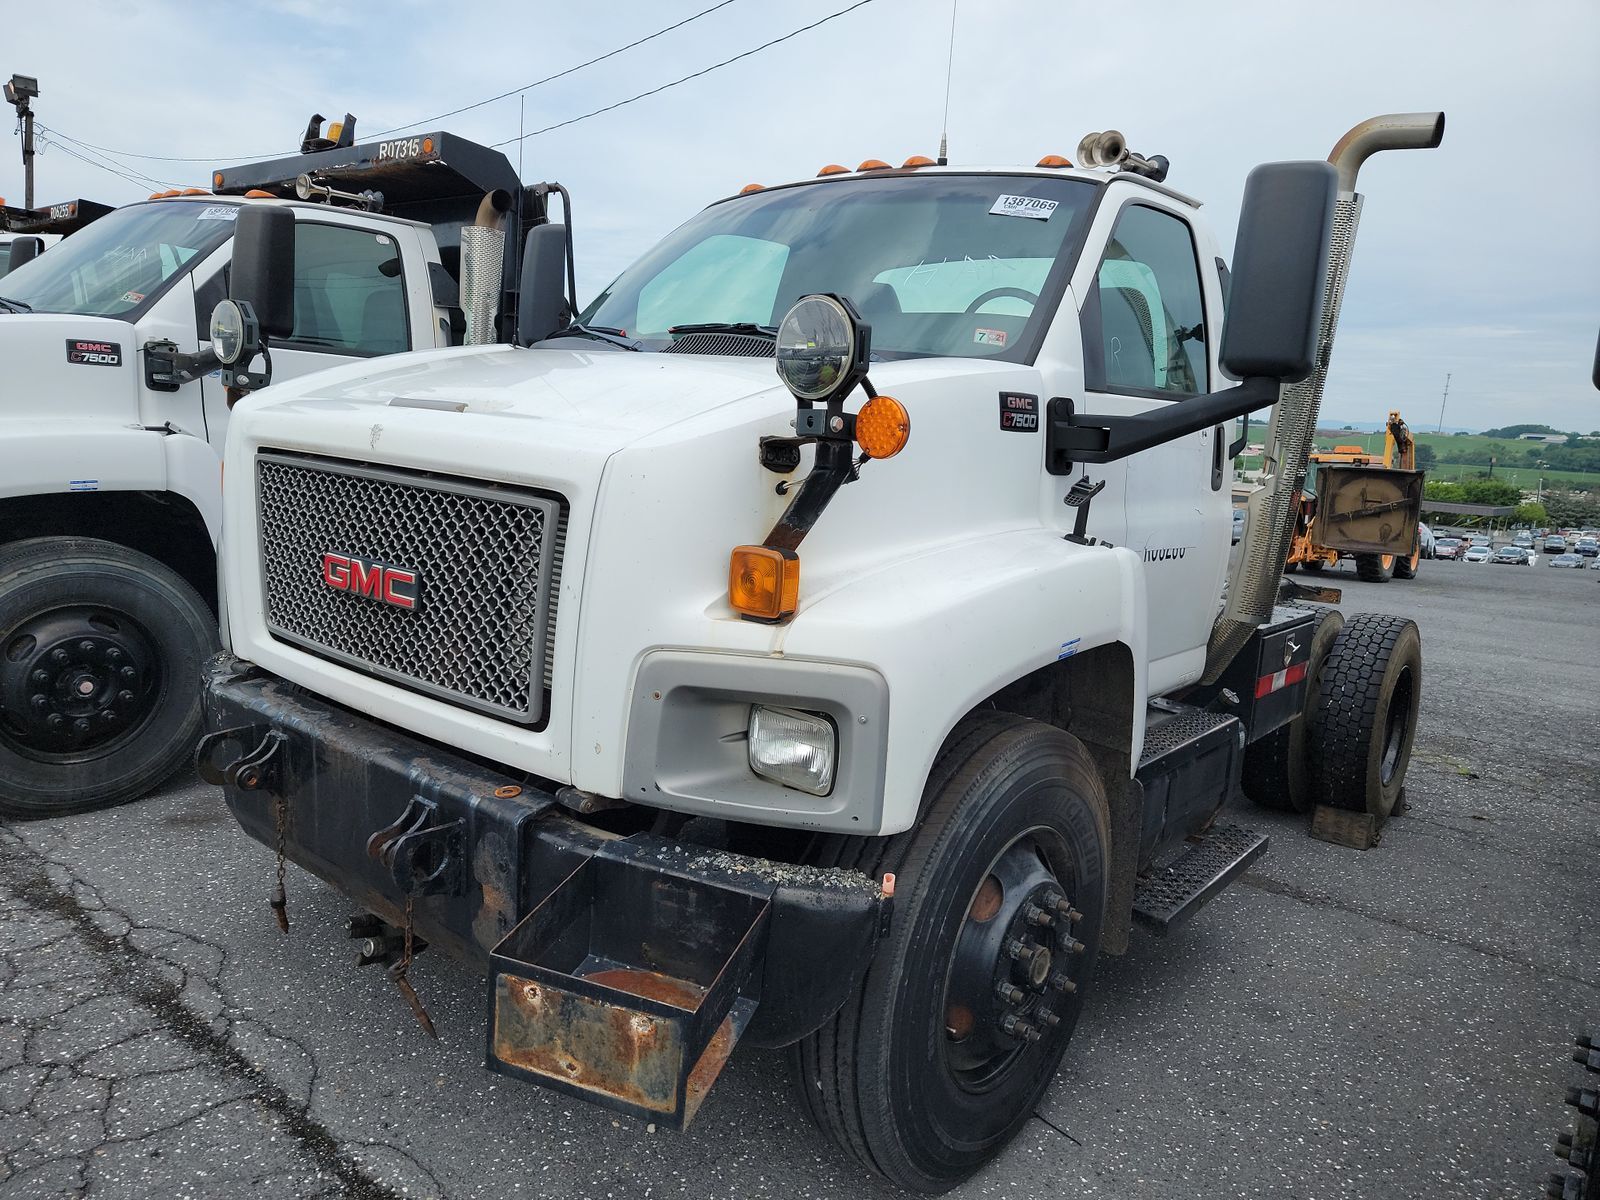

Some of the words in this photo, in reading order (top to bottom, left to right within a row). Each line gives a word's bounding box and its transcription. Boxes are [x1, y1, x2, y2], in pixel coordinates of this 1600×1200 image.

[379, 138, 420, 159] R07315
[1003, 196, 1056, 211] 1387069
[978, 332, 986, 341] 7
[75, 342, 112, 352] GMC
[70, 351, 118, 364] C7500
[1007, 396, 1033, 409] GMC
[1002, 411, 1037, 428] C7500
[324, 552, 416, 609] GMC
